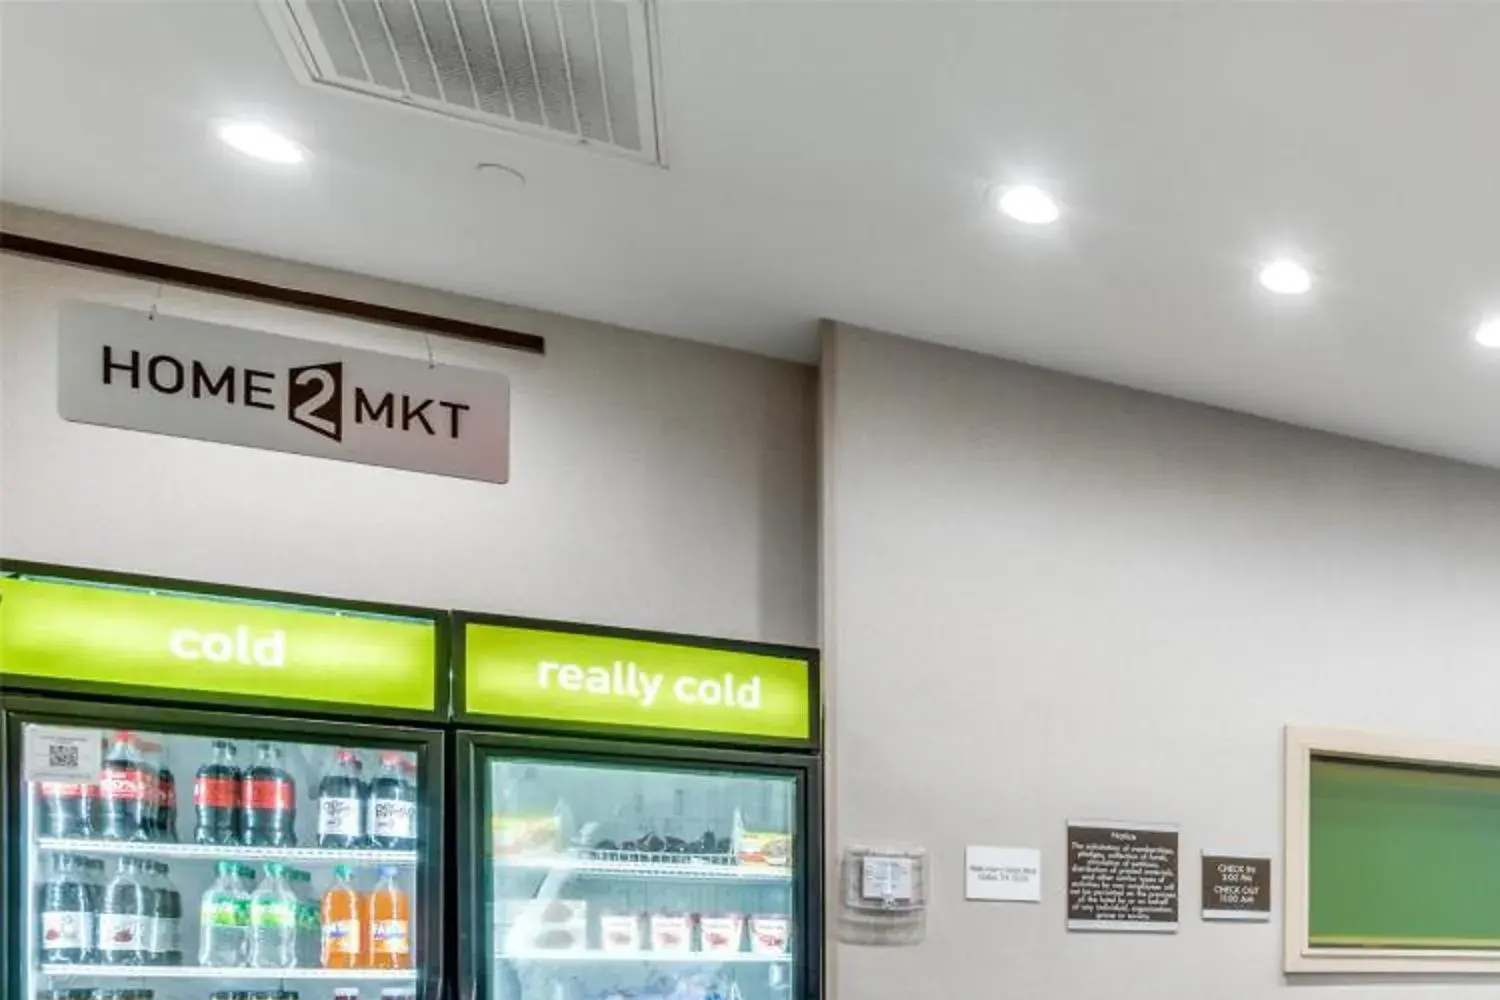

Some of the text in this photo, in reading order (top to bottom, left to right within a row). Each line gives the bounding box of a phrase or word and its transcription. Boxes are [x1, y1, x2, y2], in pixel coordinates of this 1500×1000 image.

[102, 345, 275, 410] HOME
[355, 387, 470, 439] MKT
[169, 625, 286, 668] cold
[538, 659, 761, 710] really cold
